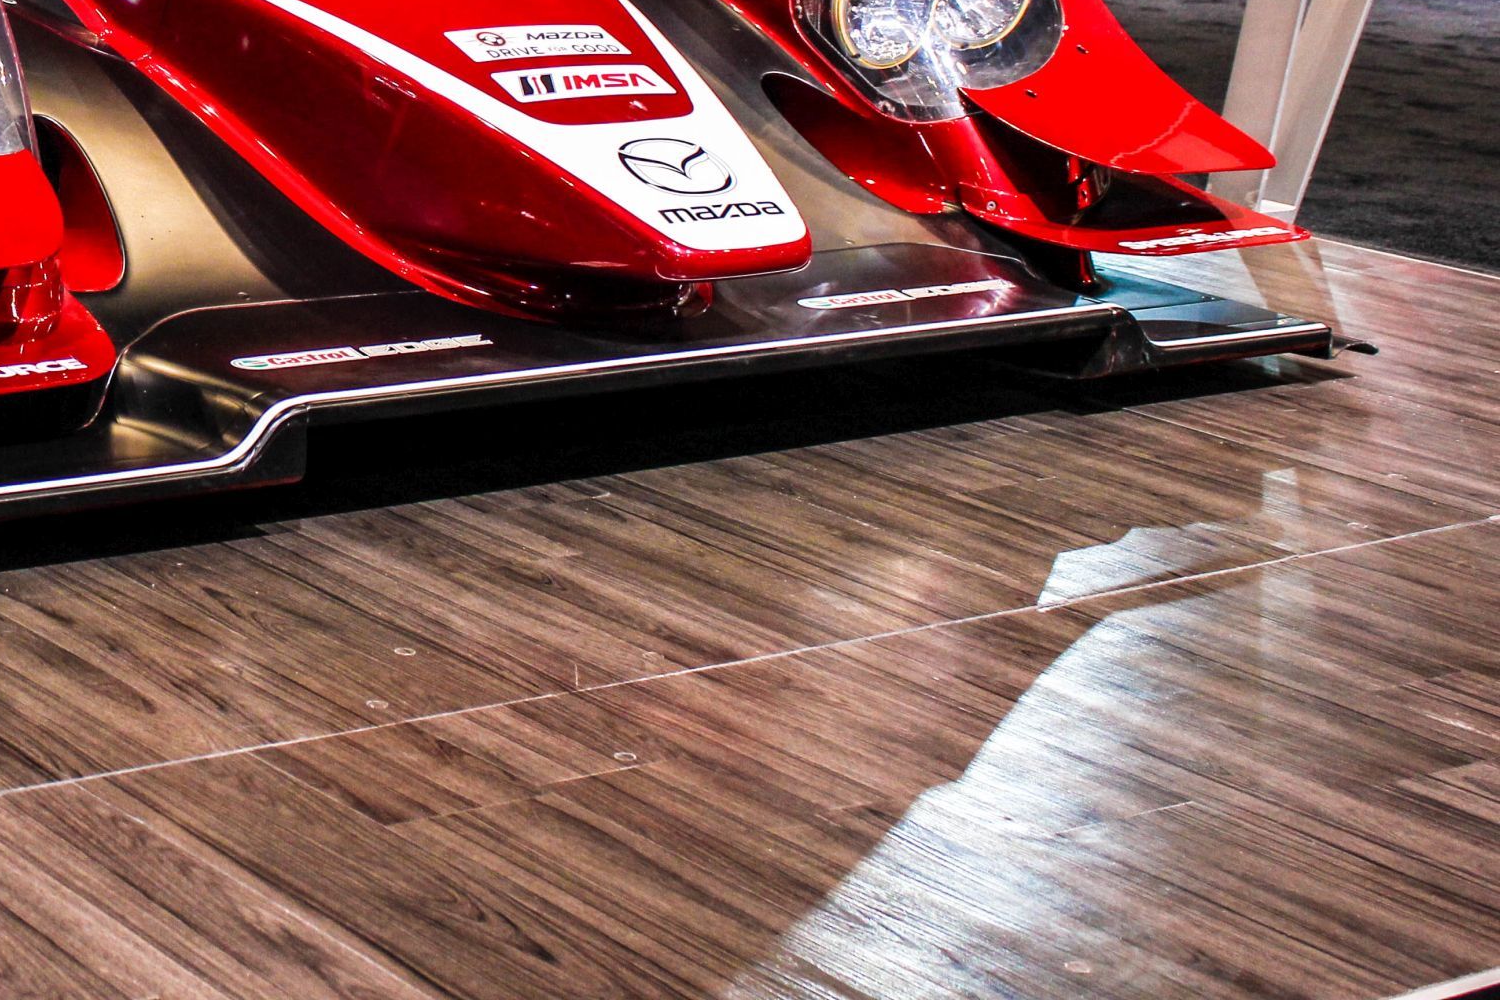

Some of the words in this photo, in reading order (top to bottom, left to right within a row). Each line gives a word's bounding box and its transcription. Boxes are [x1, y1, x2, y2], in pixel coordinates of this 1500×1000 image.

[486, 45, 546, 59] DRIVE
[571, 44, 621, 54] GOOD
[562, 73, 657, 90] IMSA
[829, 291, 900, 306] Castrol
[266, 349, 354, 367] Castrol
